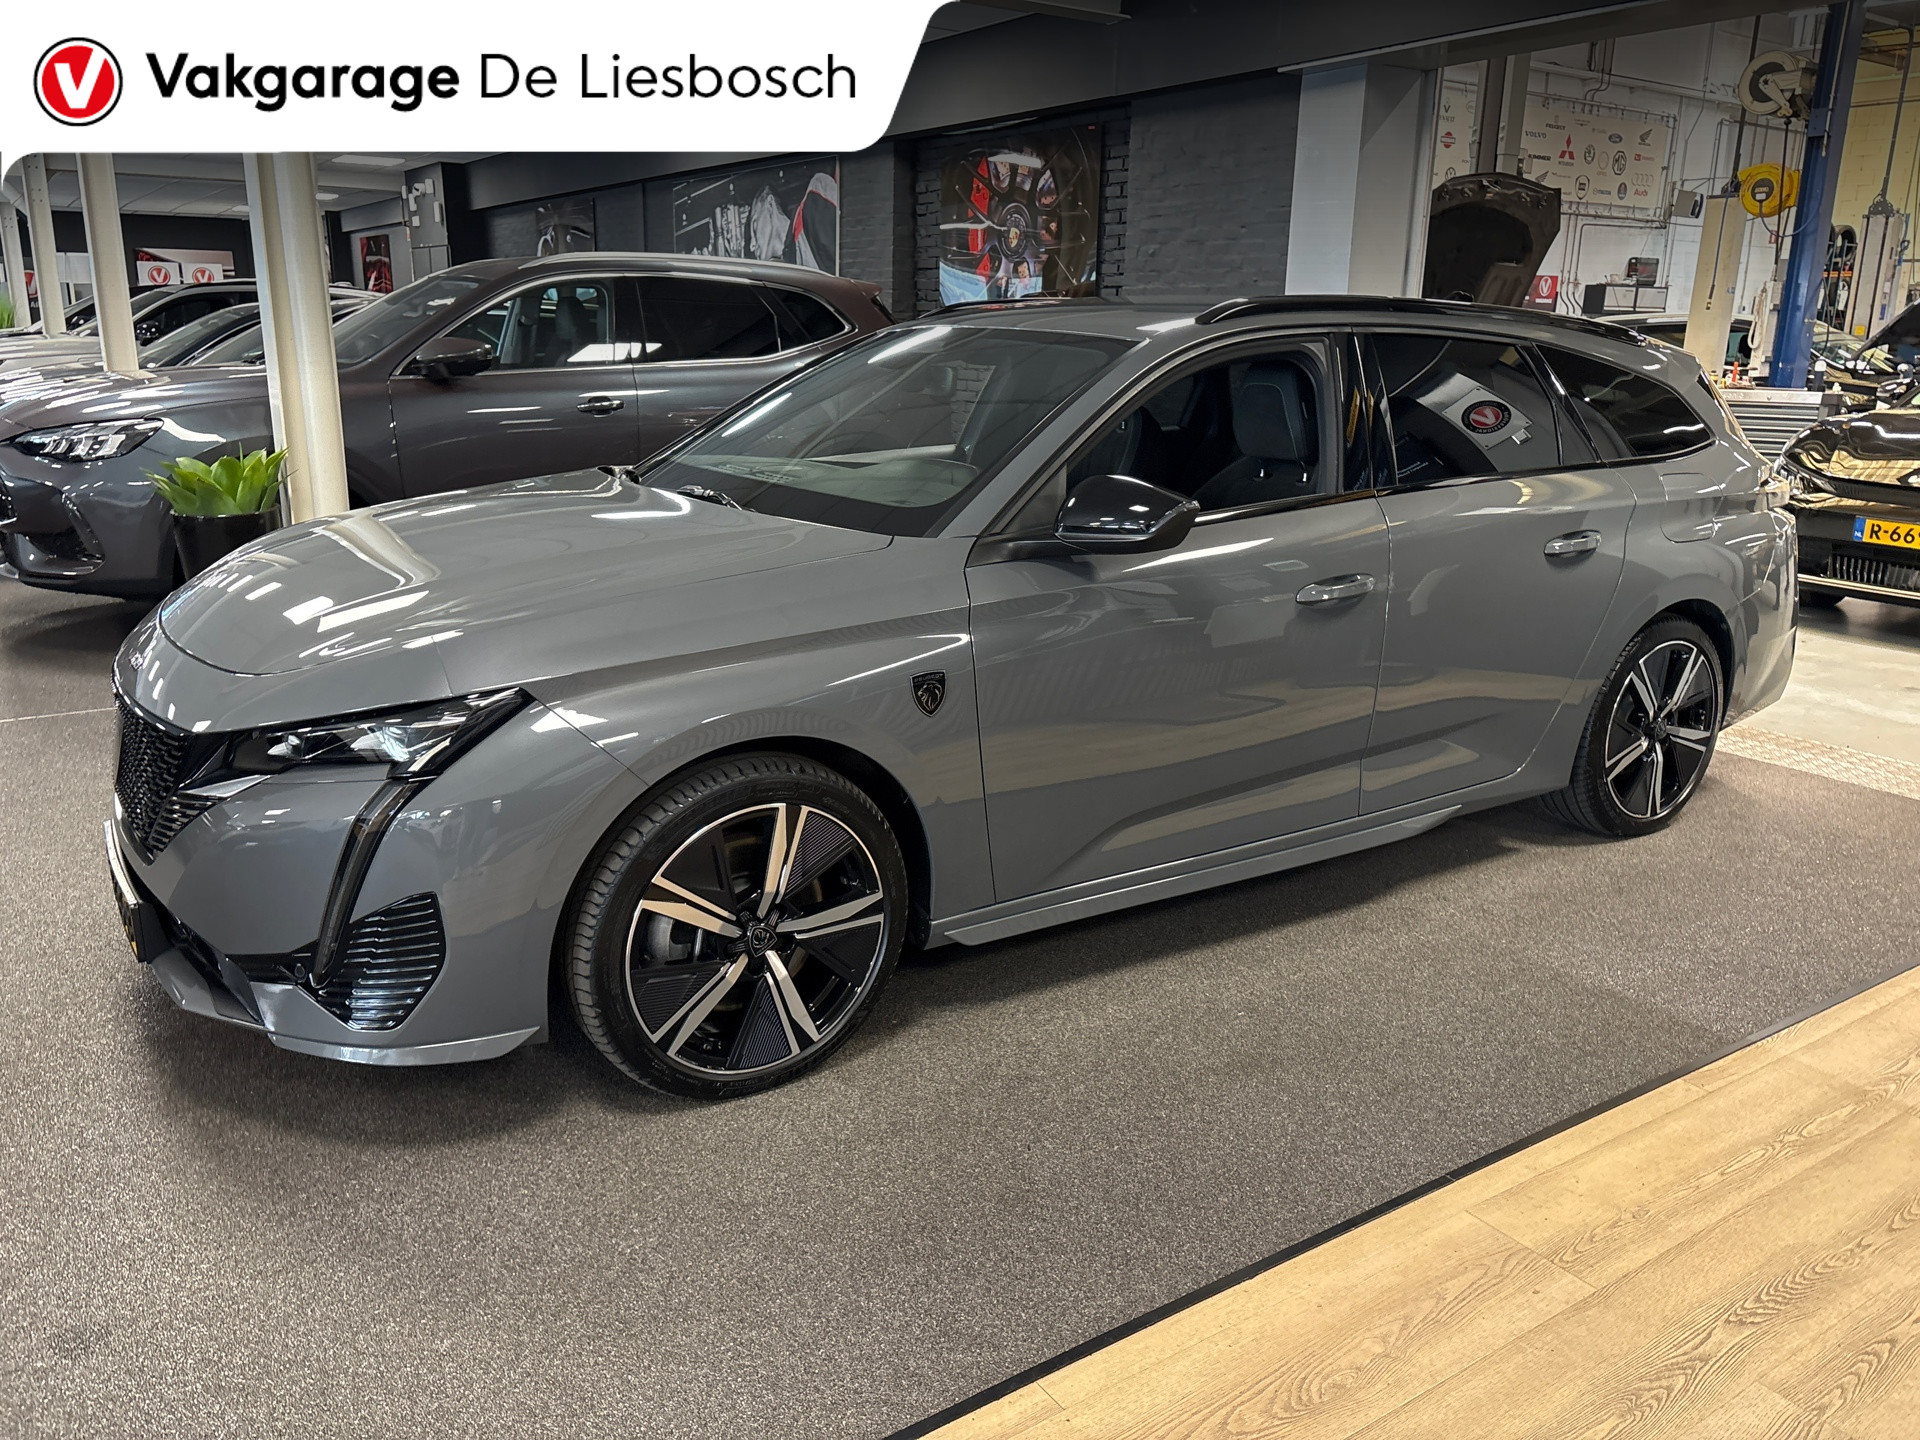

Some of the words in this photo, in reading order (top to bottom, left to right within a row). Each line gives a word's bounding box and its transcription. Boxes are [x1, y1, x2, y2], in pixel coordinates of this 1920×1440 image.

[1525, 130, 1547, 139] VOLVO
[1634, 188, 1648, 197] Audi
[1854, 530, 1863, 538] NL
[1869, 523, 1920, 544] R-66
